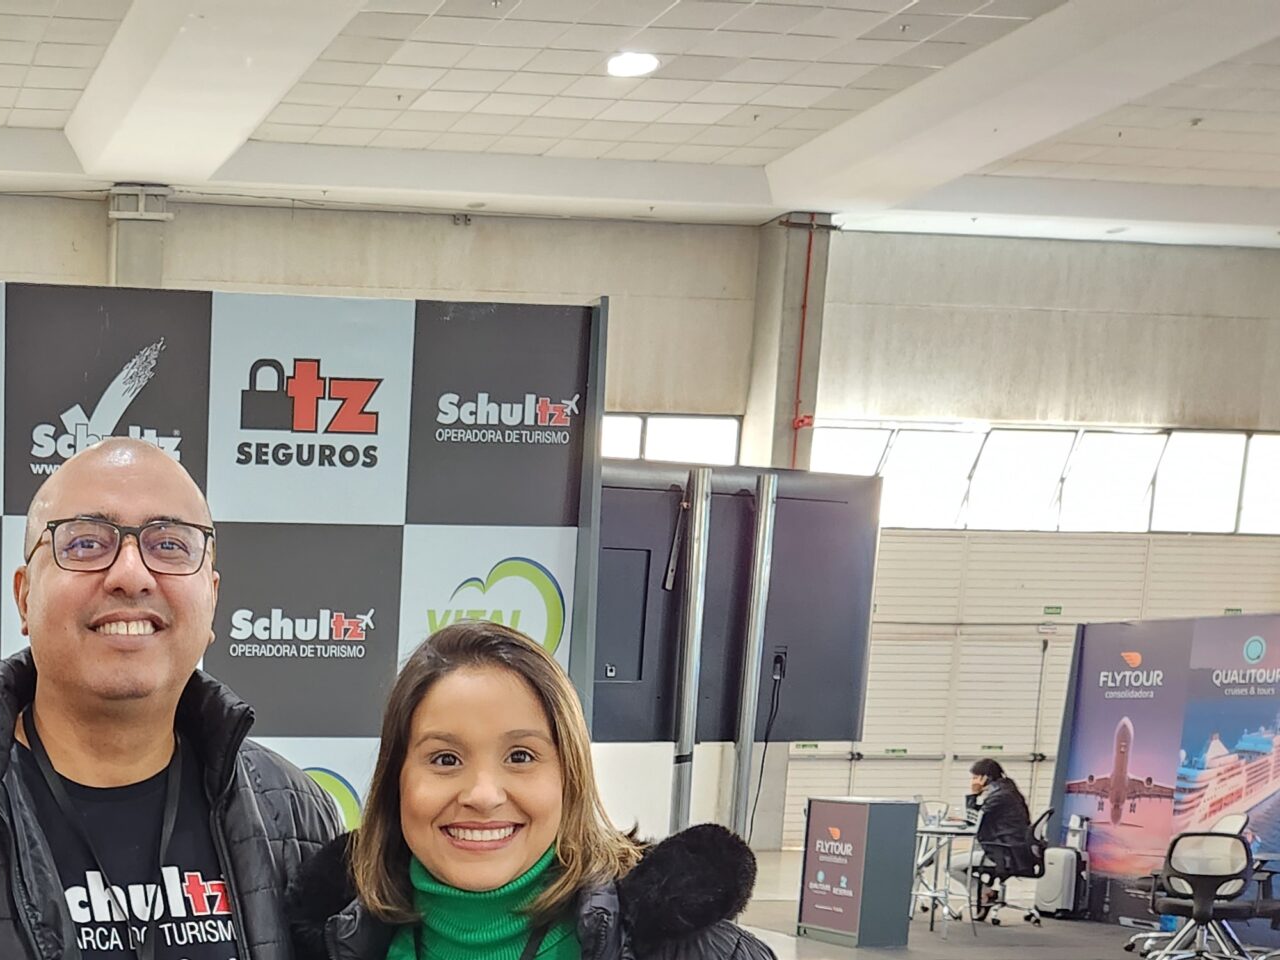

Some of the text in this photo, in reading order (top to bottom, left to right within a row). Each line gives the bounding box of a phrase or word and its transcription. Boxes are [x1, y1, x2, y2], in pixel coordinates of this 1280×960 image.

[286, 358, 384, 435] tz
[436, 392, 570, 426] Schultz
[435, 428, 570, 444] OPERADORA DE TURISMO
[236, 442, 378, 468] SEGUROS
[230, 609, 366, 641] Schultz
[230, 643, 366, 659] OPERADORA DE TURISMO
[1099, 670, 1163, 687] FLYTOUR
[815, 839, 853, 857] FLYTOUR
[64, 866, 233, 923] chultz
